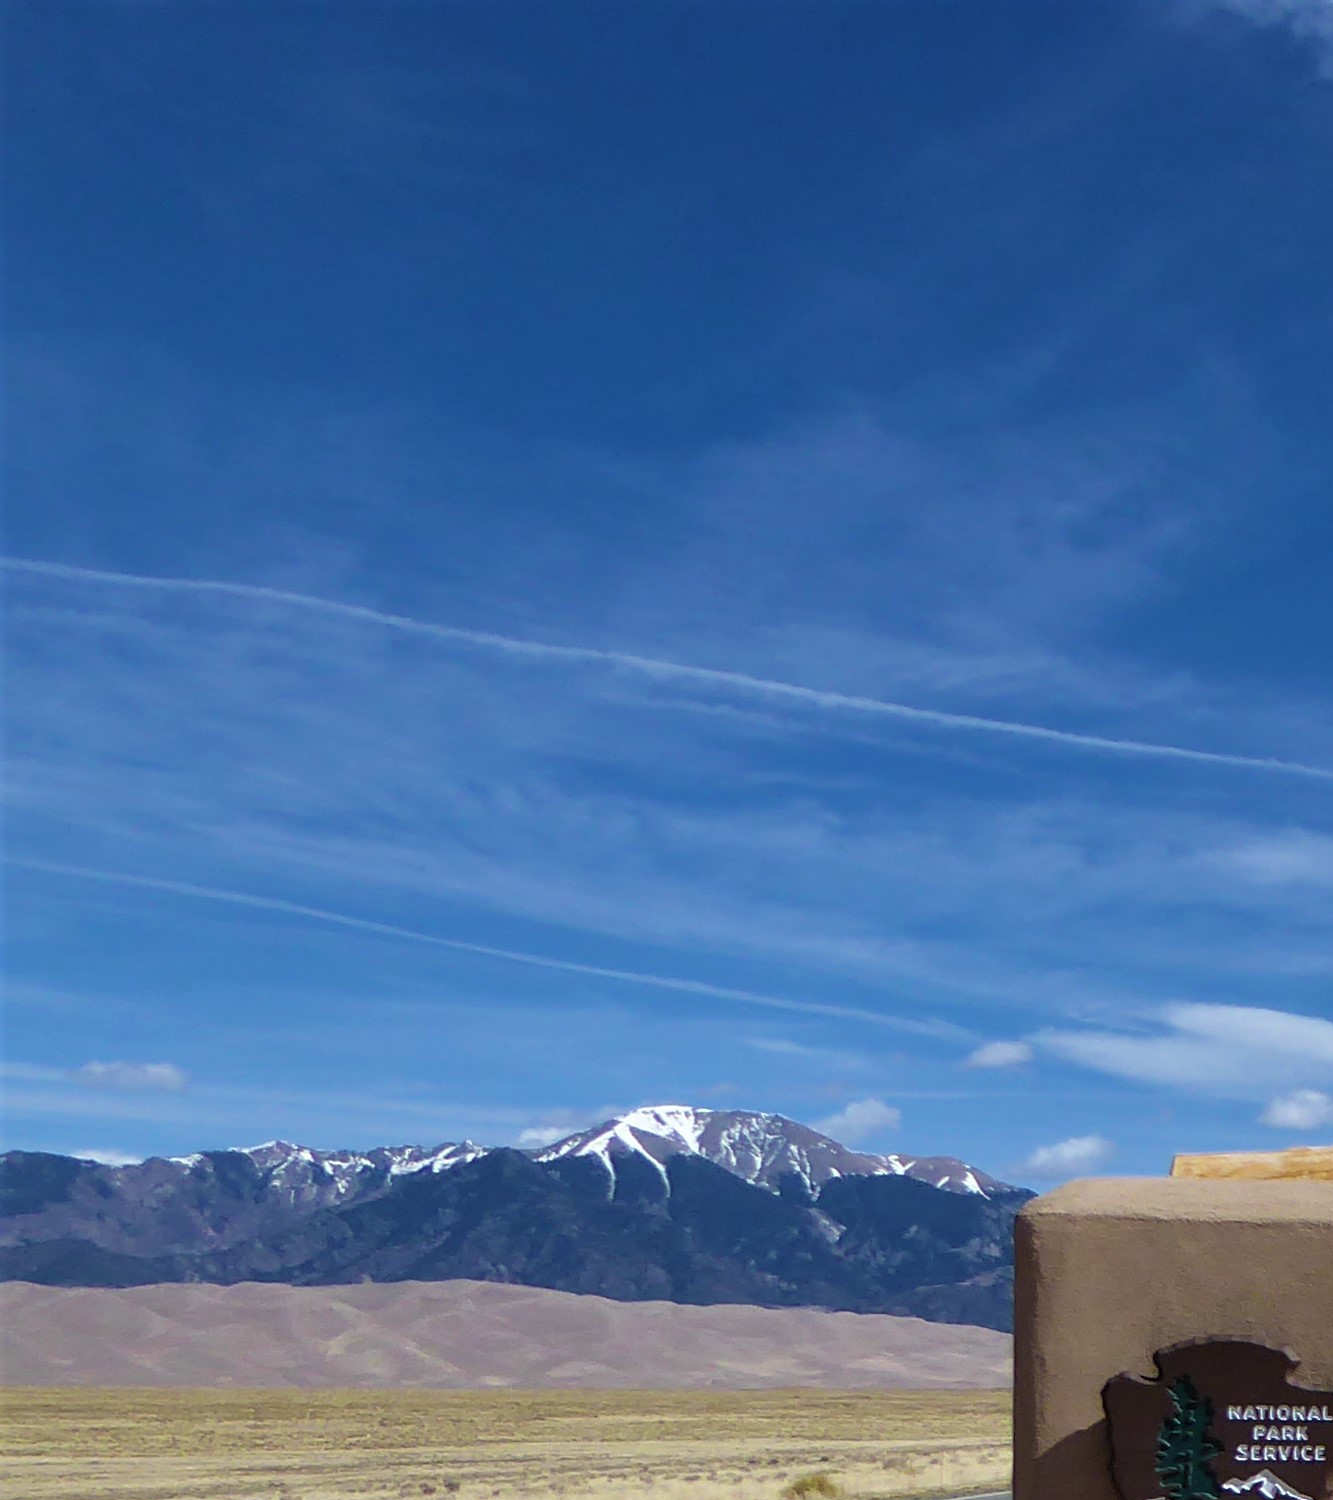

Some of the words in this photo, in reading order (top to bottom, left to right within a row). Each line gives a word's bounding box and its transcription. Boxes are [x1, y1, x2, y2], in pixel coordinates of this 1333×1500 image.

[1227, 1405, 1333, 1422] NATIONAL
[1253, 1425, 1309, 1441] PARK
[1234, 1444, 1327, 1462] SERVICE
